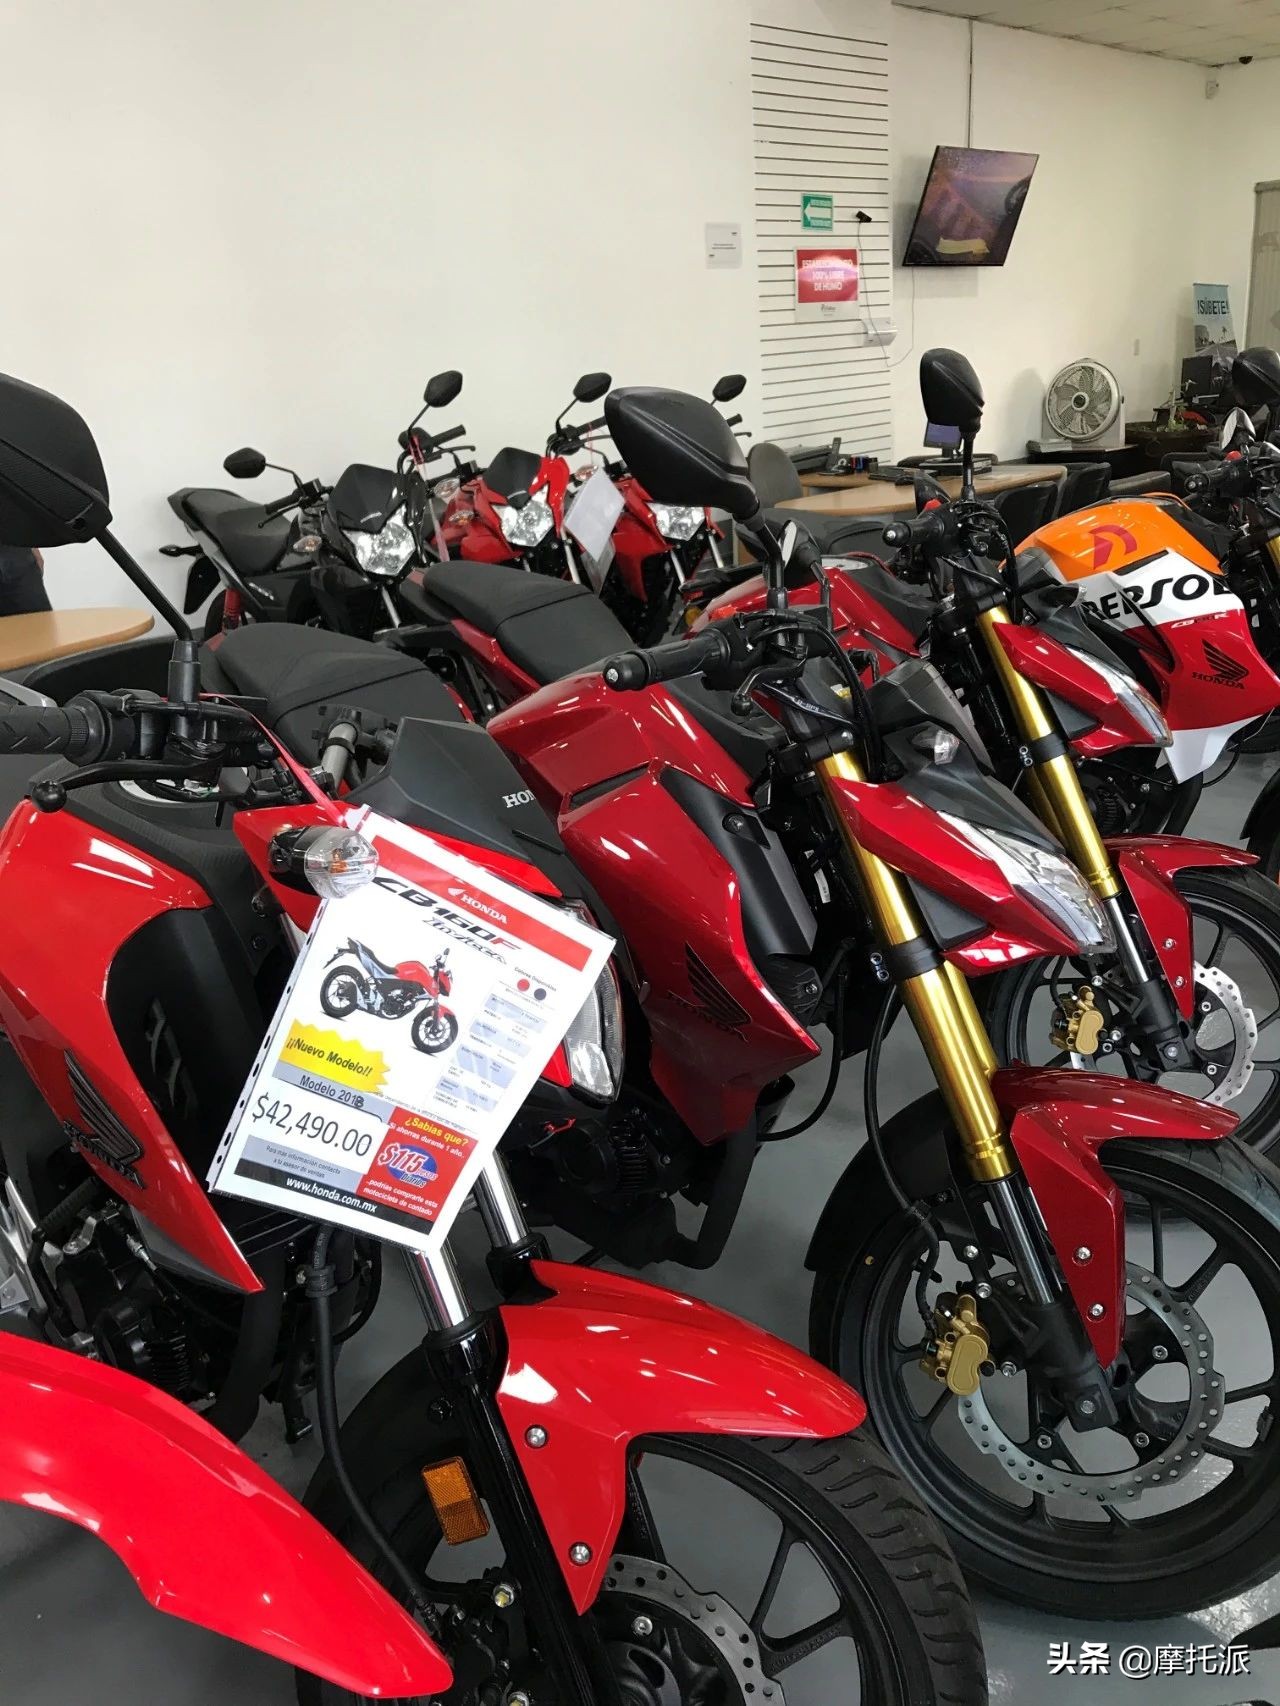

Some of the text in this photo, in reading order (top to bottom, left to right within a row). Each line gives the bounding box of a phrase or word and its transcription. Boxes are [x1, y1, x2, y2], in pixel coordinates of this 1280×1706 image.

[1192, 671, 1245, 689] HONDA
[461, 894, 508, 924] HONDA
[326, 1051, 373, 1077] Modelo!!
[299, 1075, 336, 1097] Modelo
[252, 1092, 373, 1156] $42,490.00
[396, 1124, 420, 1140] ahorras
[420, 1134, 445, 1150] durante
[443, 1131, 469, 1147] que?
[377, 1142, 427, 1175] $115
[286, 1177, 377, 1213] www.honda.com.mx
[363, 1187, 433, 1216] motocicleta de contado
[393, 1187, 424, 1203] comprarte
[424, 1199, 438, 1208] esta
